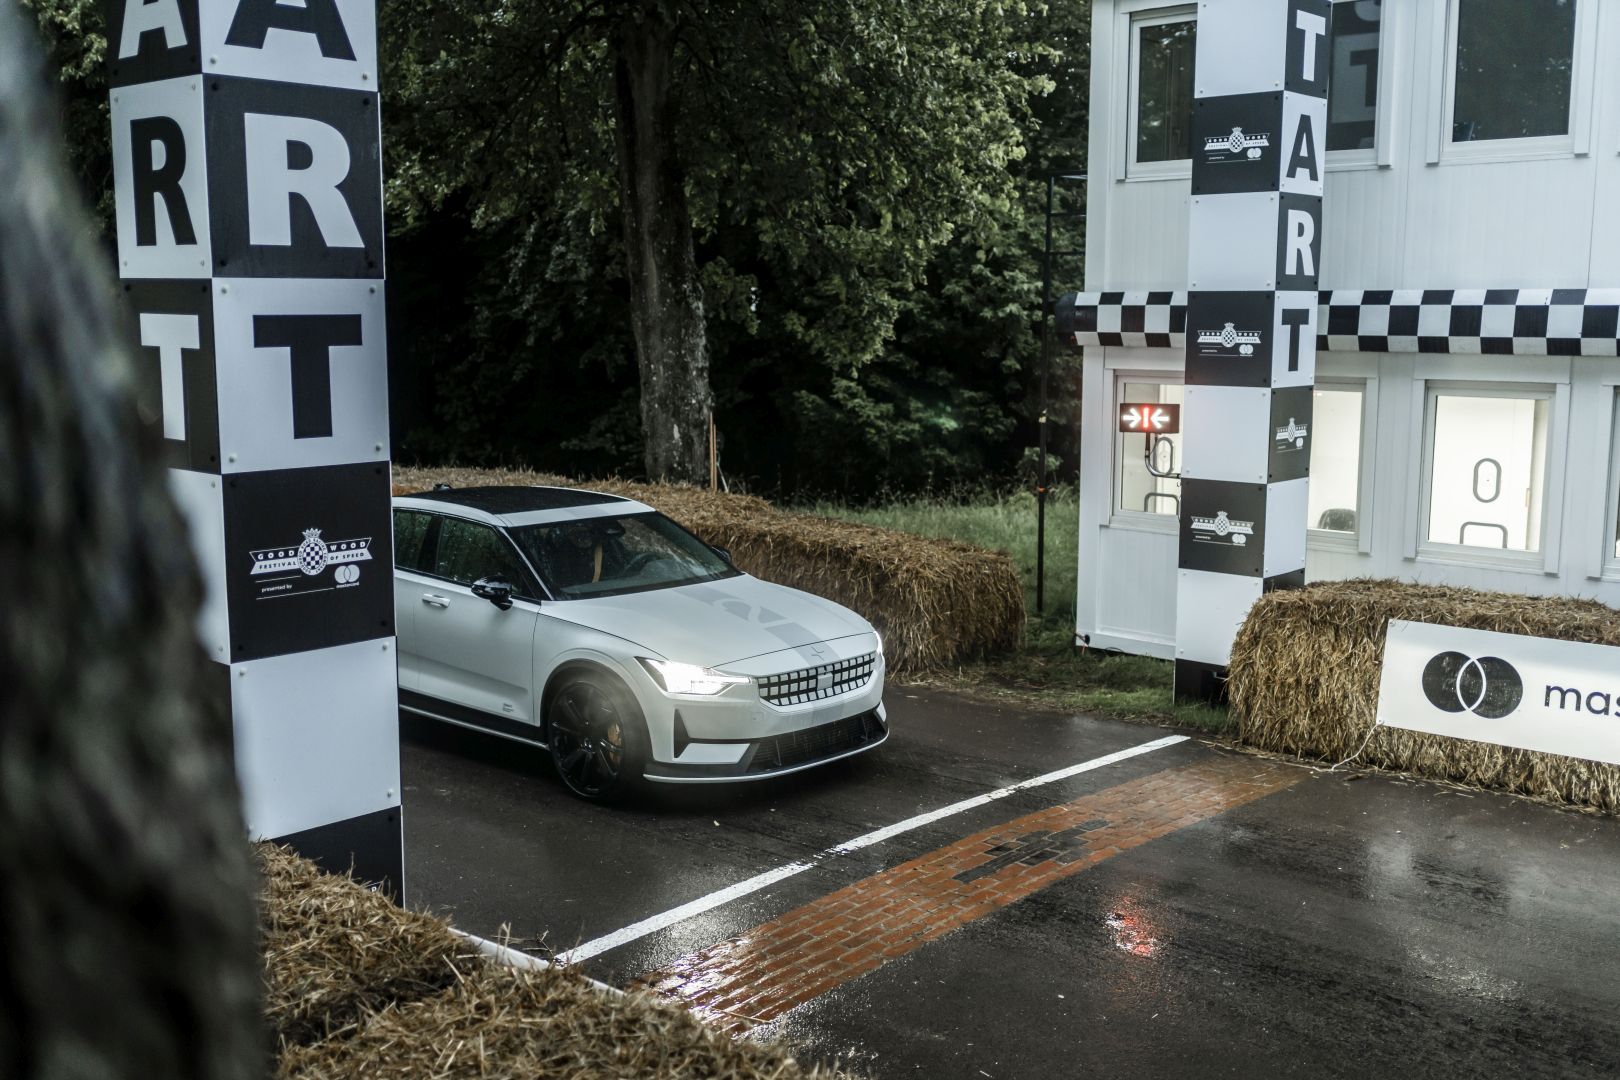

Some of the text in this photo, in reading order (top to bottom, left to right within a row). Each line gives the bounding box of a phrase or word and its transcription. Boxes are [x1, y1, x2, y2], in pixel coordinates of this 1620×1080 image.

[257, 541, 366, 560] GOOD WOOD
[259, 561, 297, 570] FESTIVAL
